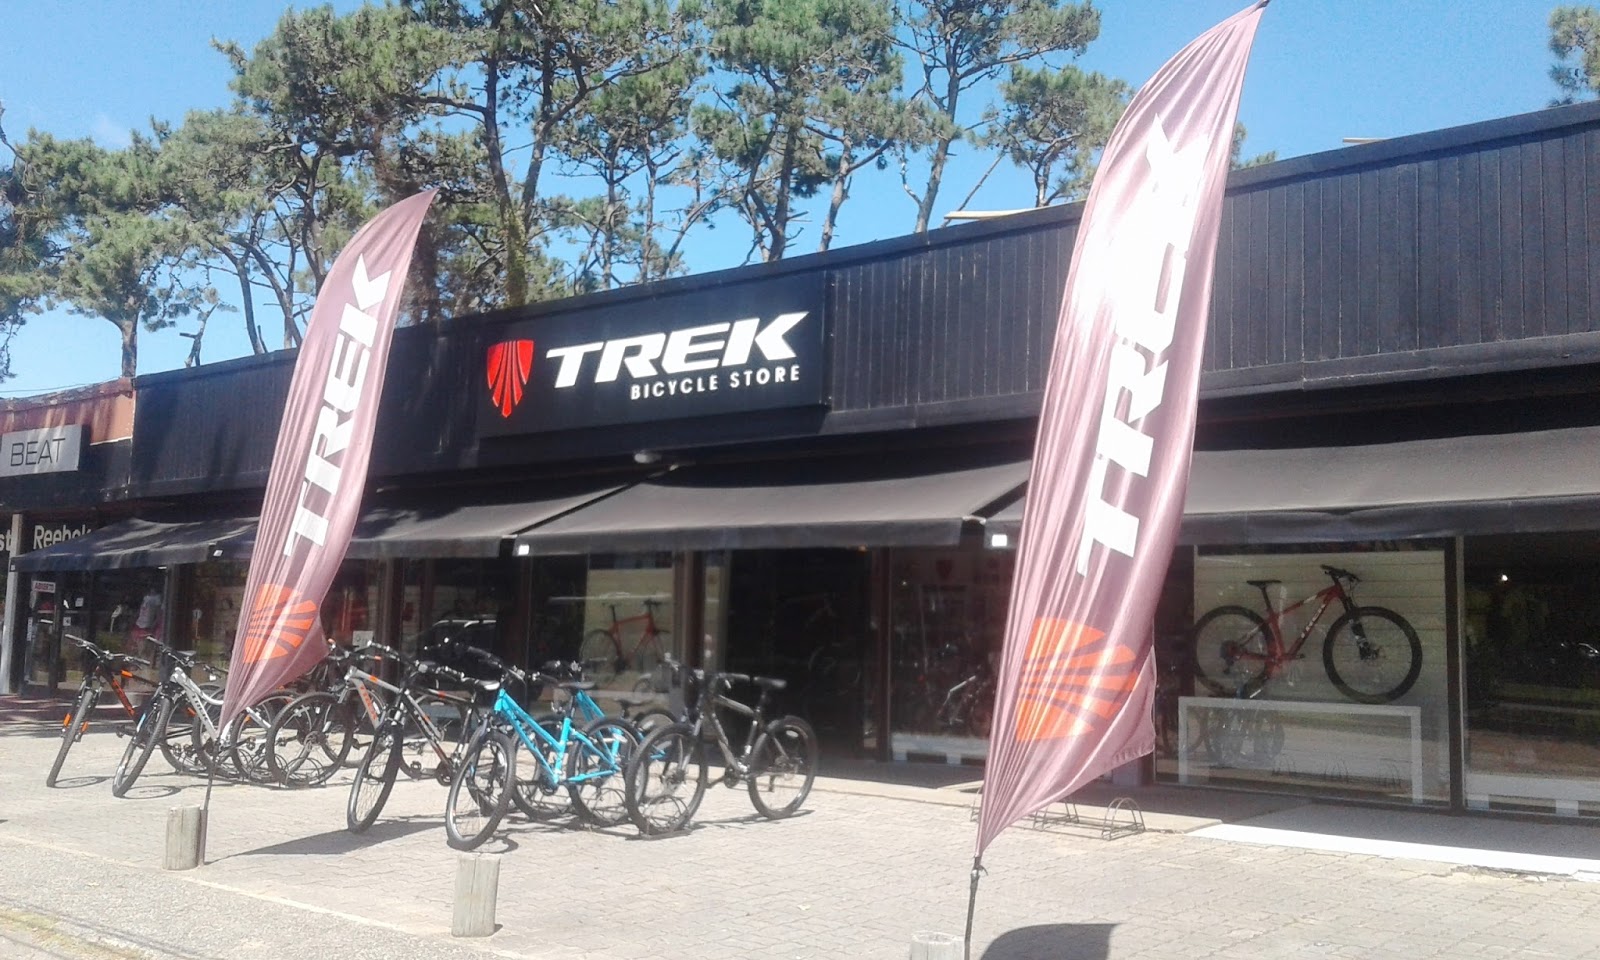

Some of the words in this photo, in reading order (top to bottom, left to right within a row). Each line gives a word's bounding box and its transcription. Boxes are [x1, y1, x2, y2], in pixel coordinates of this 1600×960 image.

[545, 311, 809, 389] TREK
[283, 252, 393, 558] TREK
[630, 375, 718, 400] BICYCLE
[729, 364, 800, 389] STORE
[9, 437, 66, 467] BEAT
